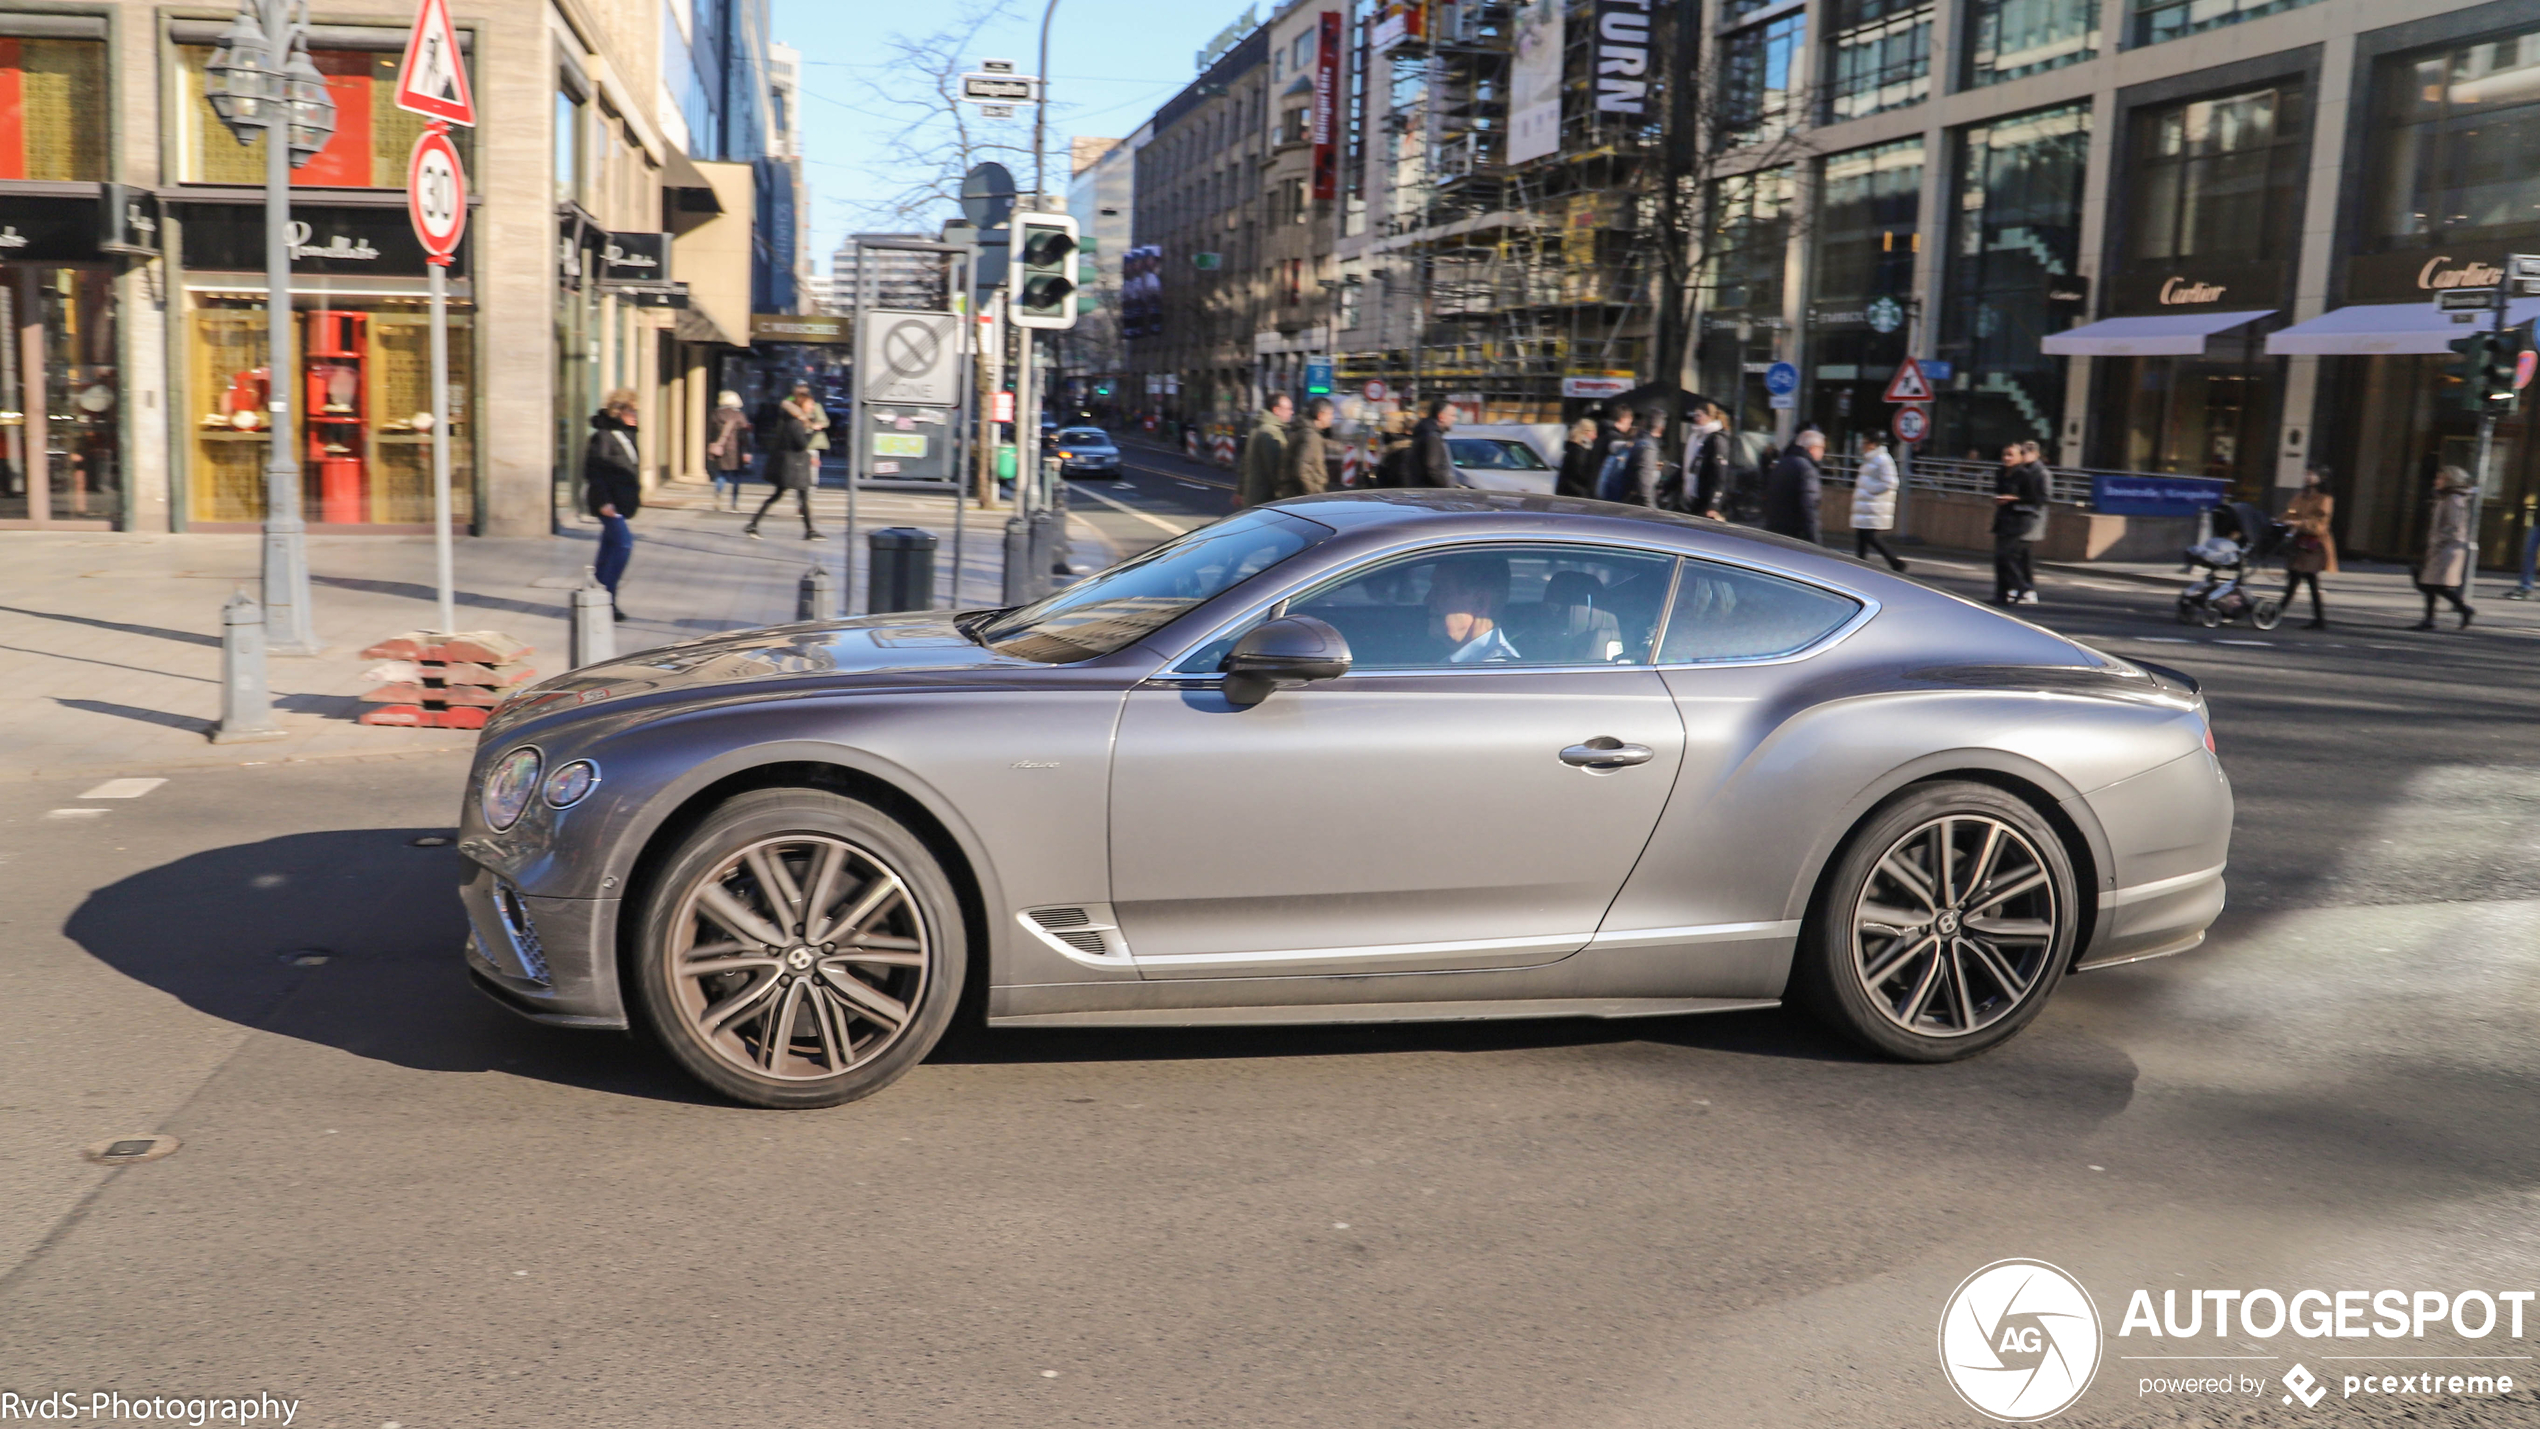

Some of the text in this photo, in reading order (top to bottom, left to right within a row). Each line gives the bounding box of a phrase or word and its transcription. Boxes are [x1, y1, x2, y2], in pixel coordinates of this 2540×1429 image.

[423, 165, 452, 220] 30
[2418, 255, 2505, 290] Cartier
[2160, 276, 2227, 305] Cartier
[888, 381, 935, 400] ZONE
